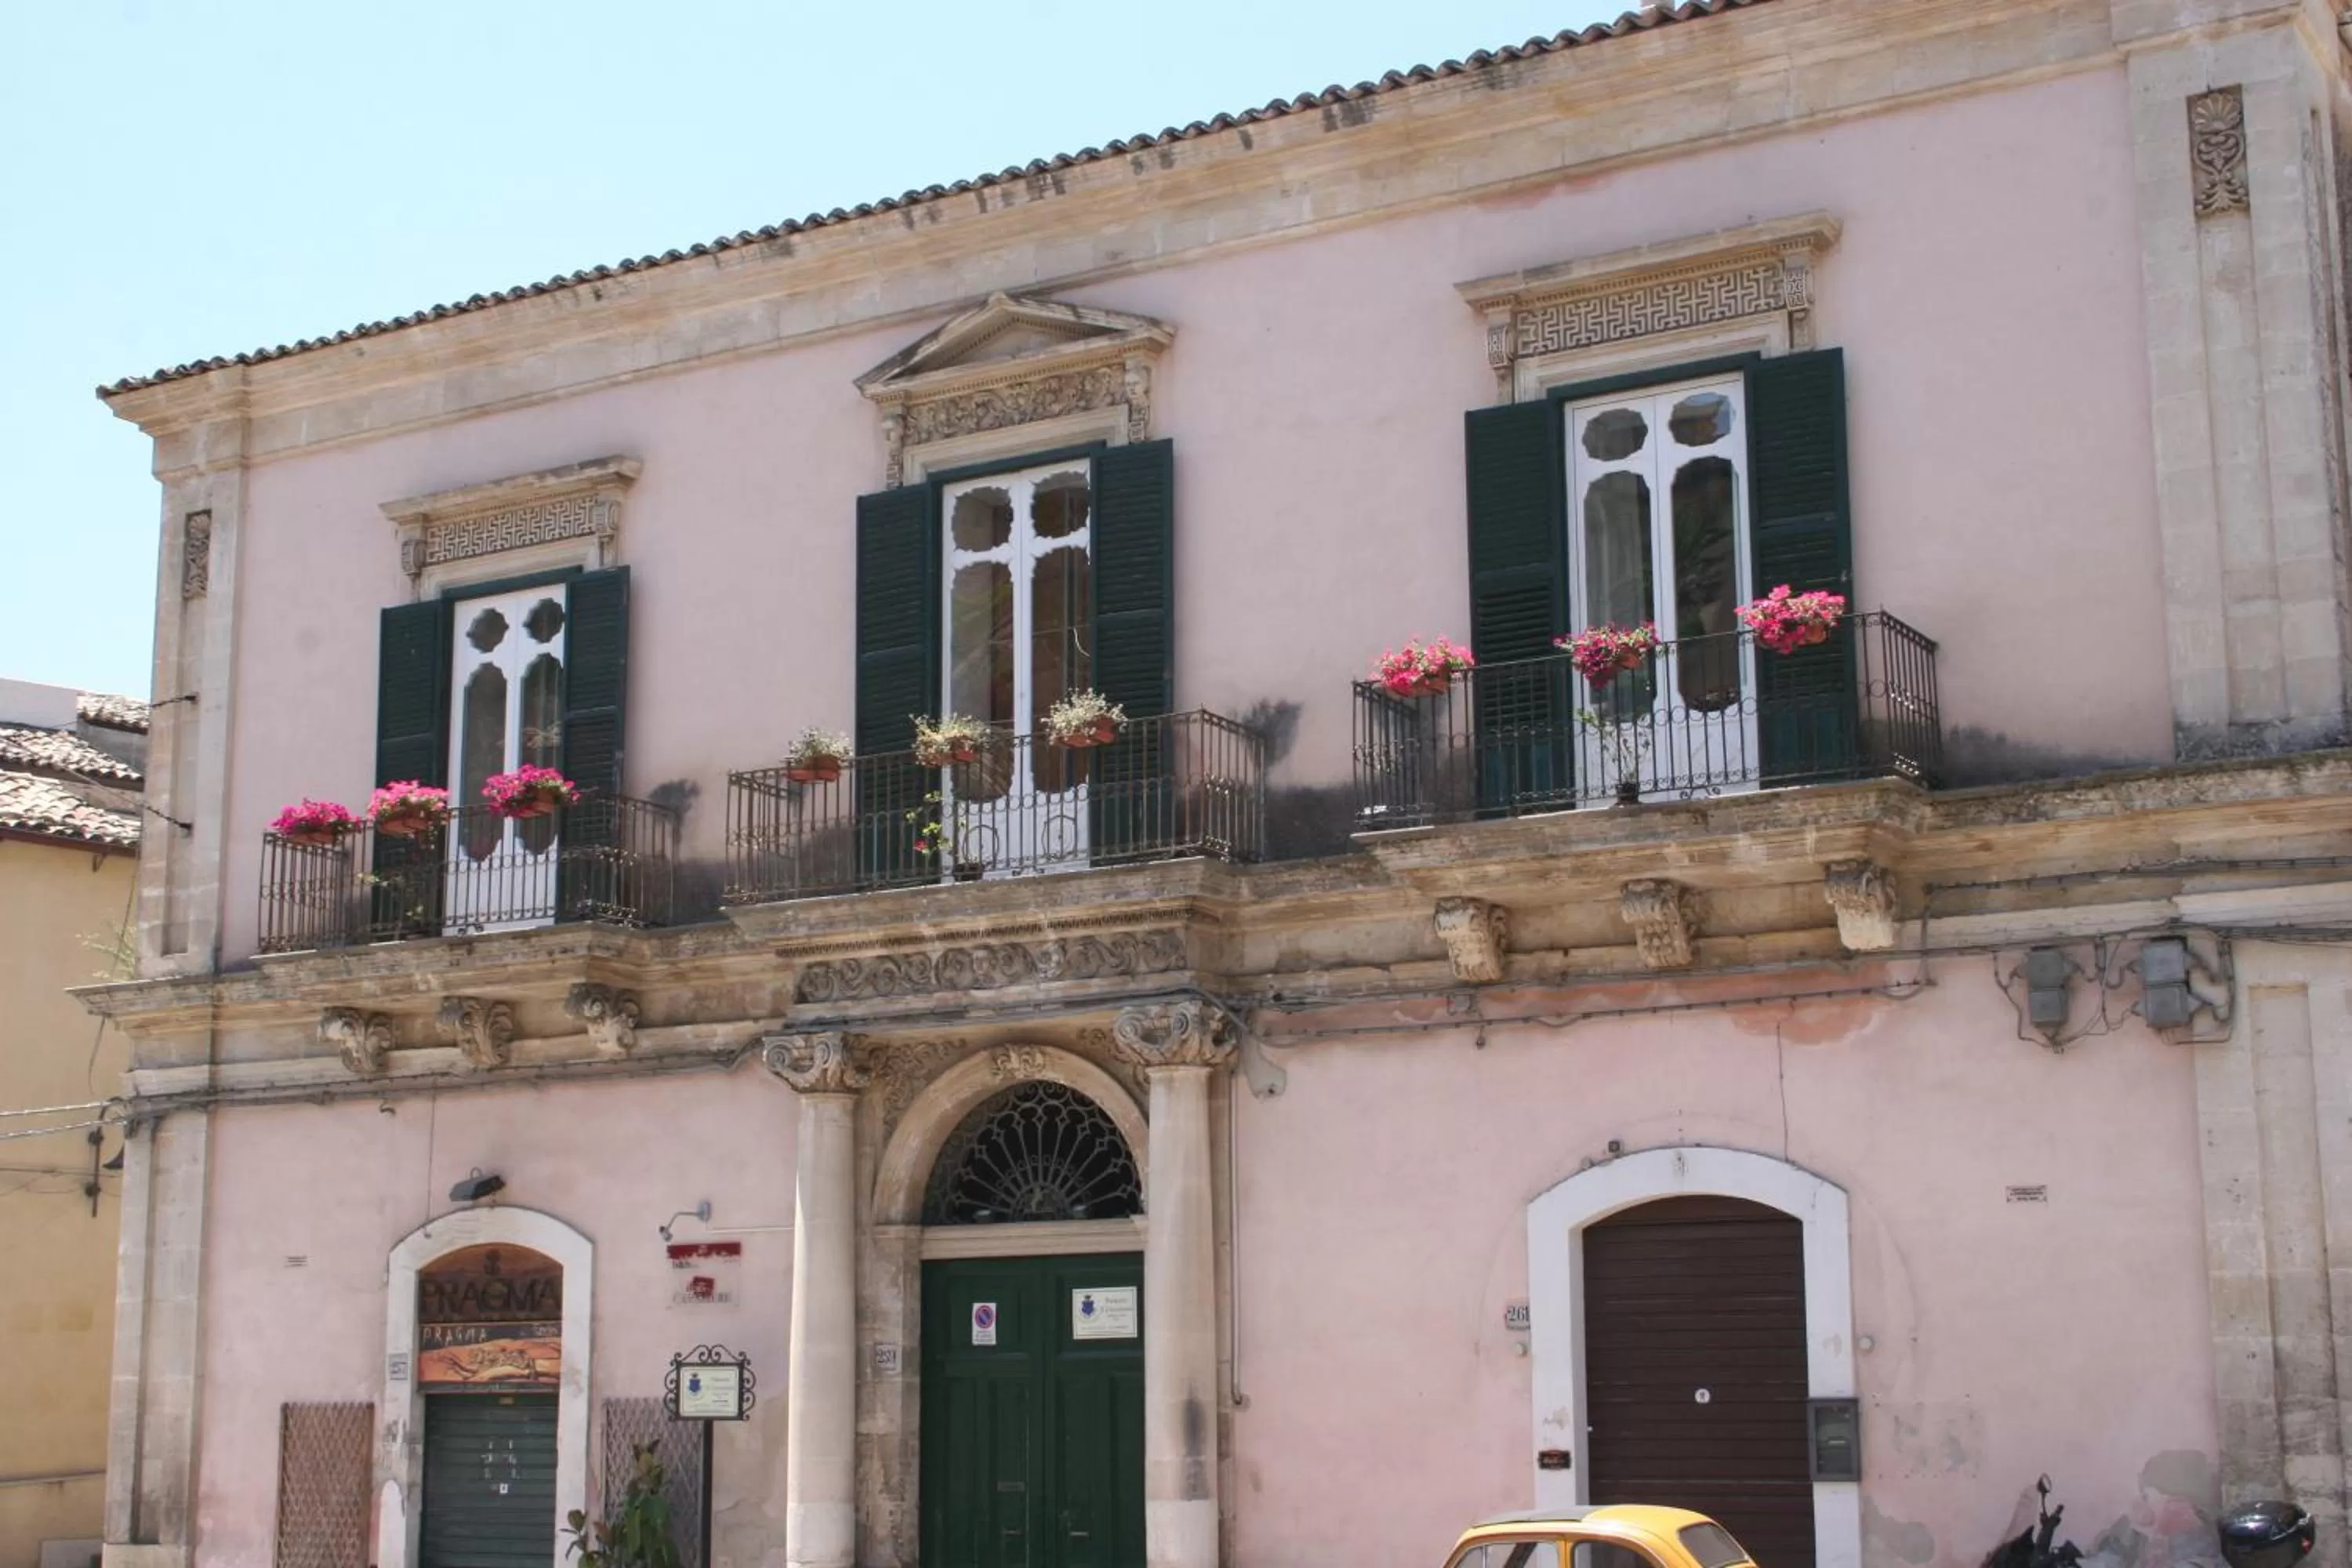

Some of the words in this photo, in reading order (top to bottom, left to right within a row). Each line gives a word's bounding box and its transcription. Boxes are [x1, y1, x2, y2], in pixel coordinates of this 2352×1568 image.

[419, 1278, 563, 1315] PRAGMA
[1507, 1305, 1530, 1322] 261
[423, 1326, 487, 1346] PRAGMA
